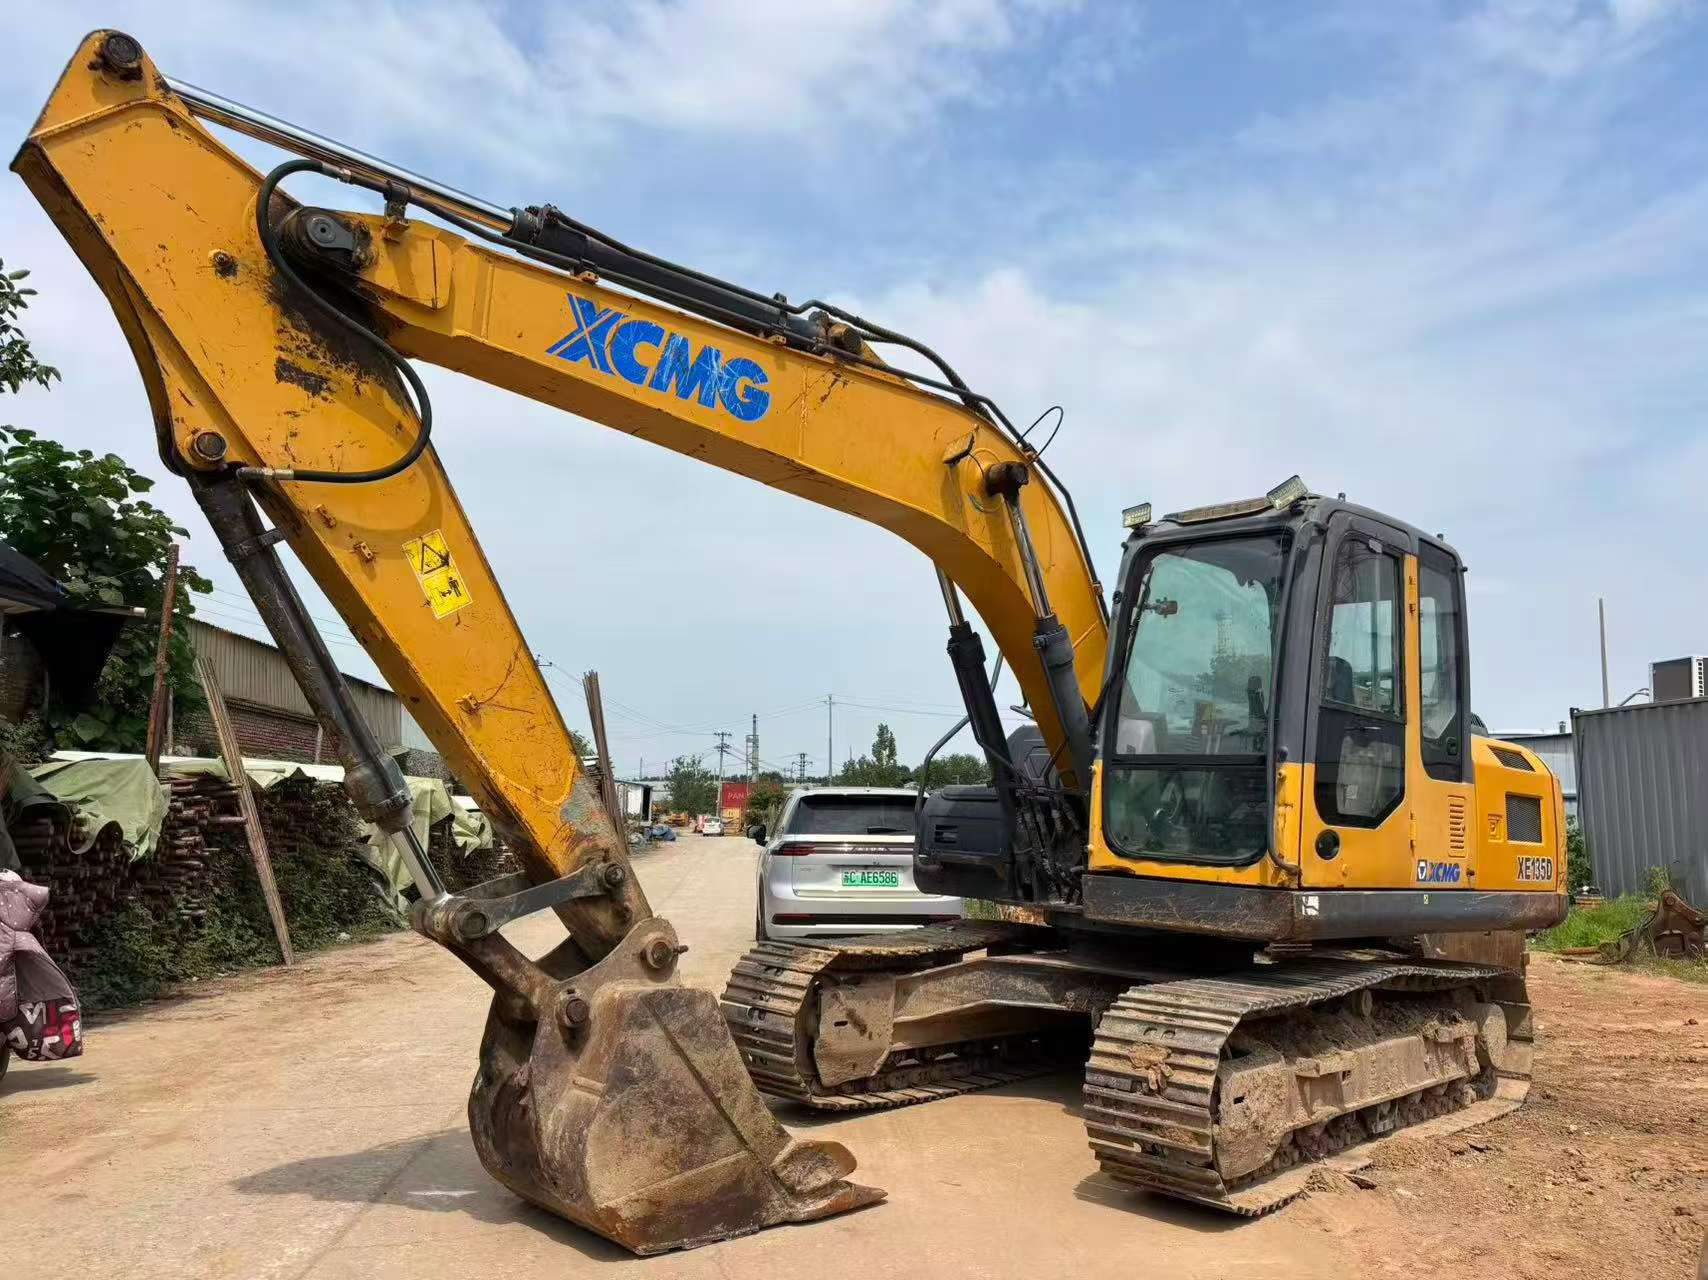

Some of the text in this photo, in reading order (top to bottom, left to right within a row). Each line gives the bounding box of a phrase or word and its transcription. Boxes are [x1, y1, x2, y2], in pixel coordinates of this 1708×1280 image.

[546, 293, 771, 422] XCMG
[861, 871, 897, 884] AE6586
[1427, 863, 1461, 882] XCMG
[1517, 857, 1553, 880] XE135D
